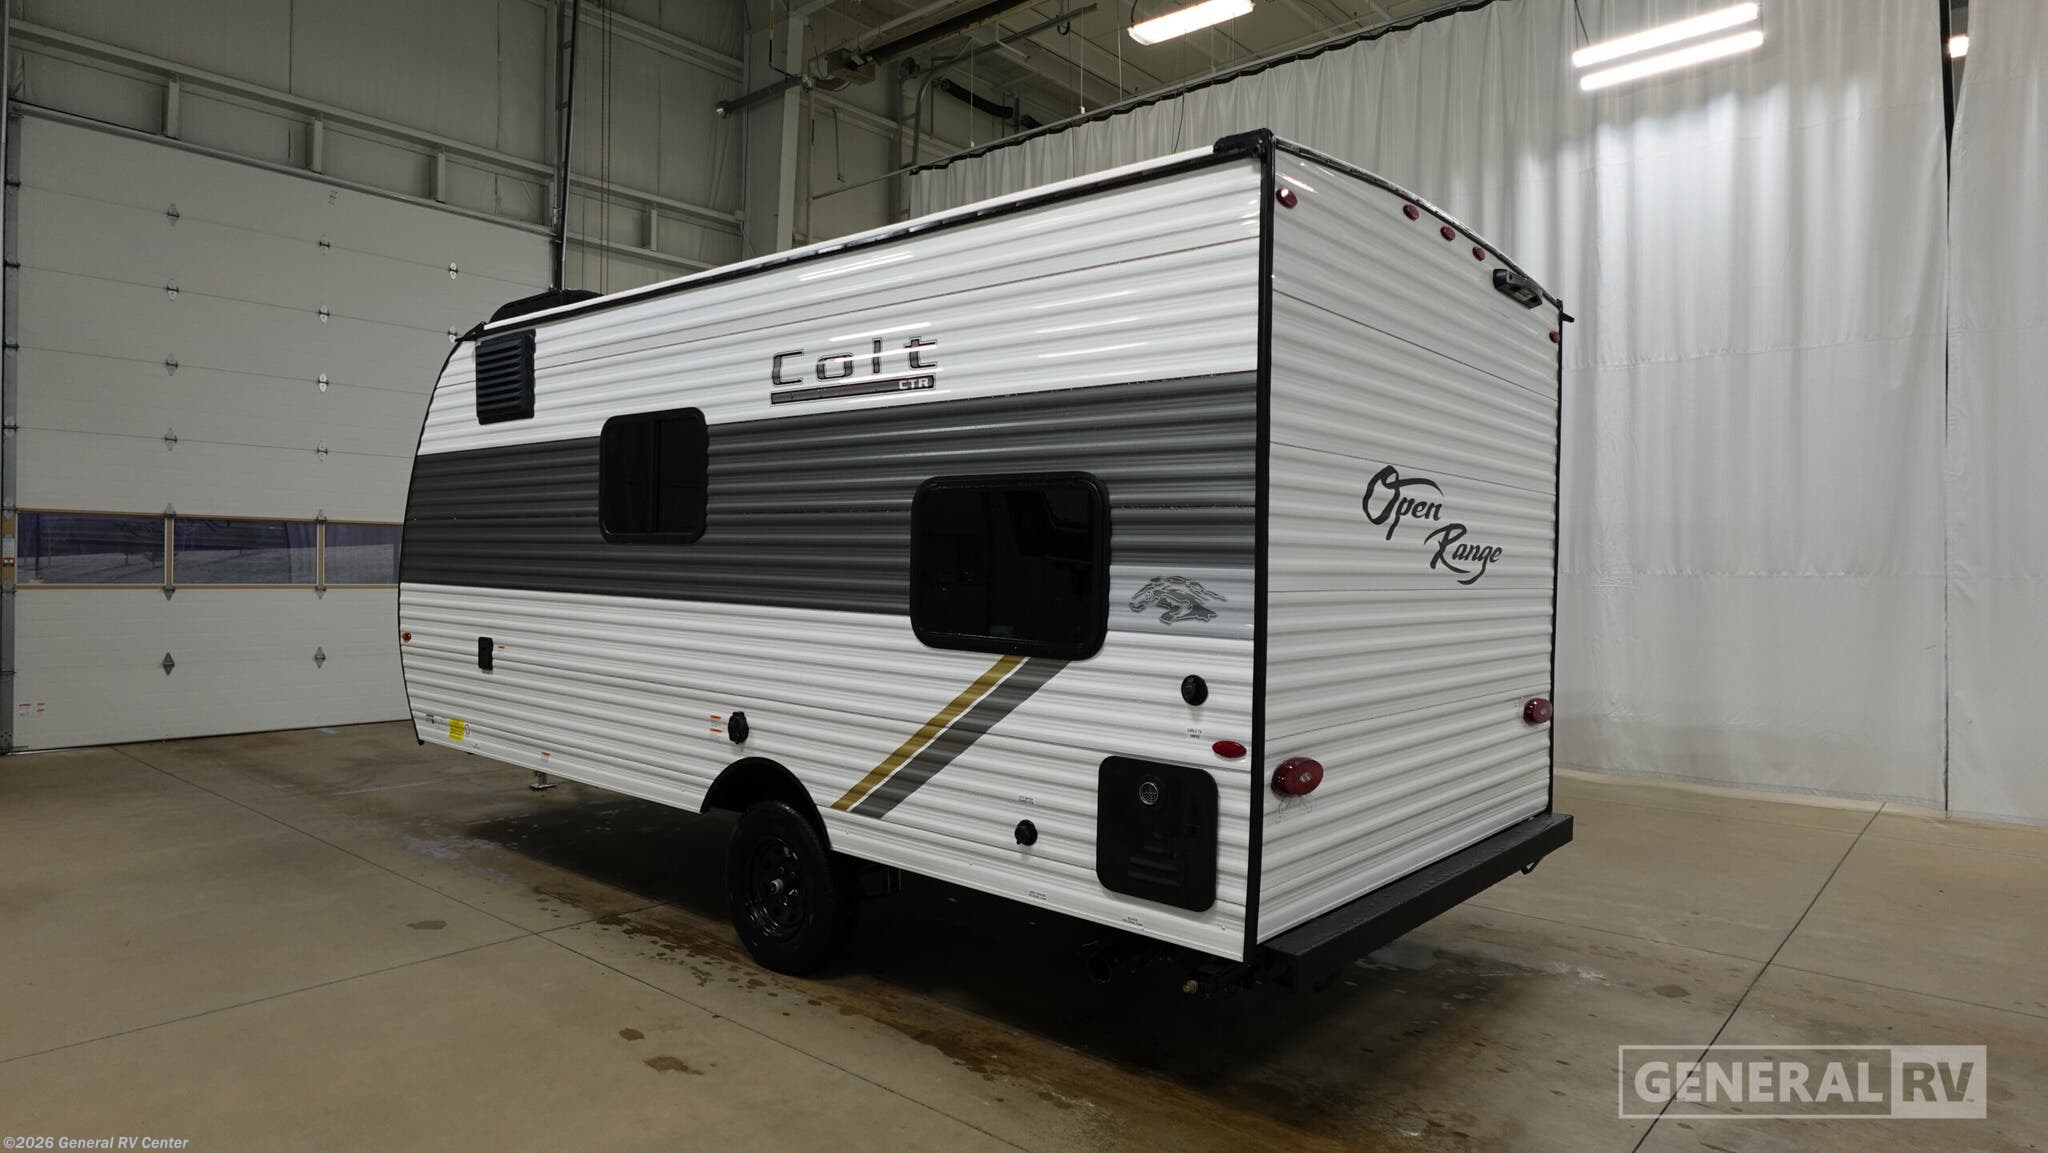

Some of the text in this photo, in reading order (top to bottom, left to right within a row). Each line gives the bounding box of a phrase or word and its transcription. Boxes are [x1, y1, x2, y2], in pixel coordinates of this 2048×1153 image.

[771, 336, 938, 386] Colt
[899, 378, 930, 390] CTR
[1362, 465, 1444, 541] Open
[1424, 523, 1503, 586] Range
